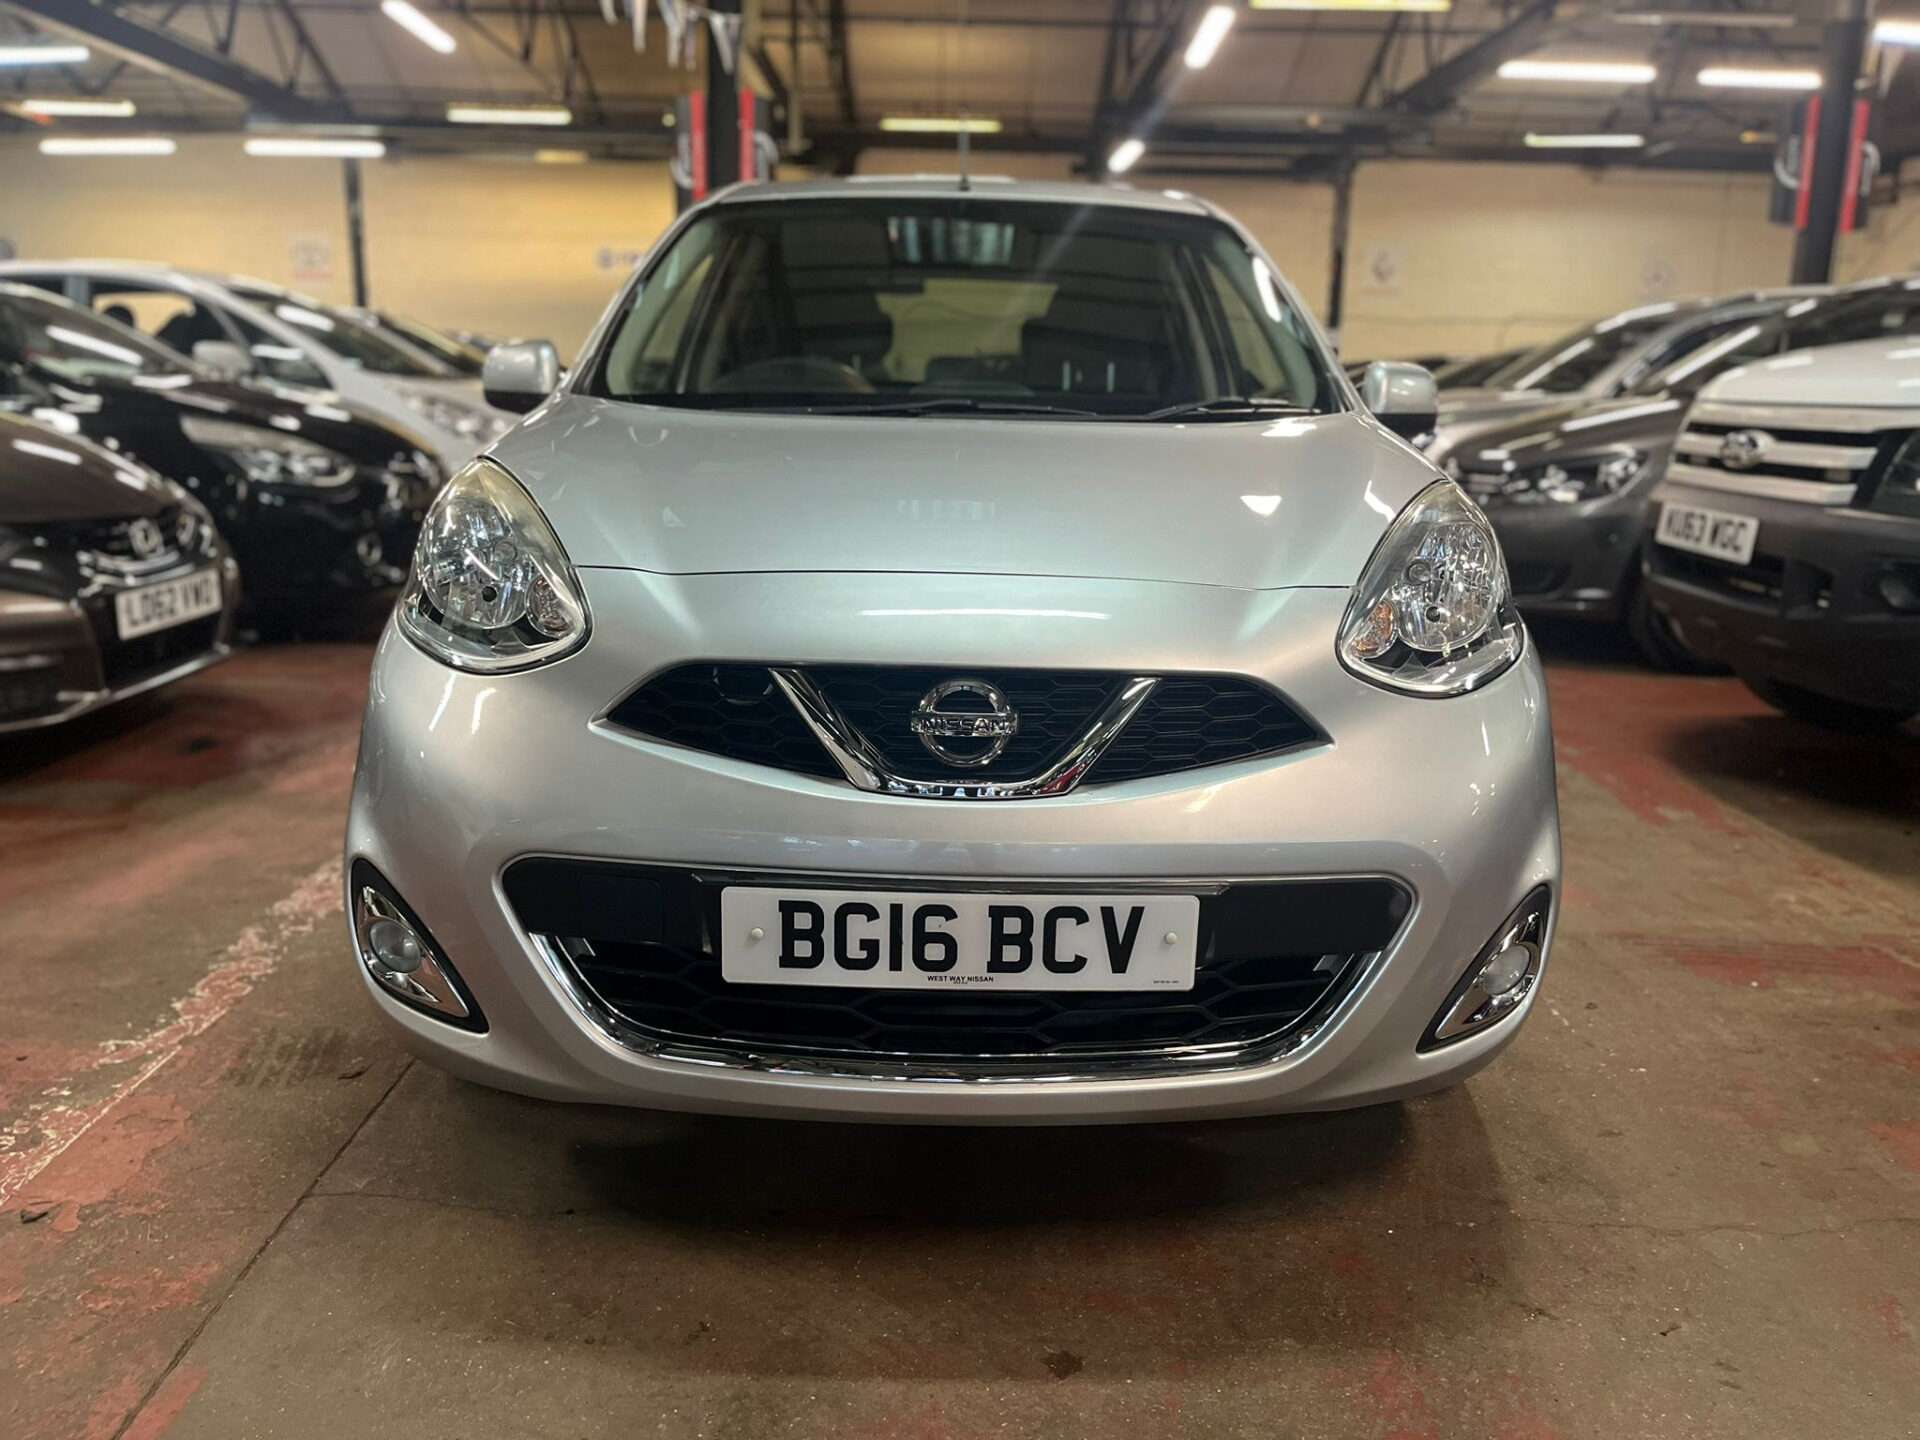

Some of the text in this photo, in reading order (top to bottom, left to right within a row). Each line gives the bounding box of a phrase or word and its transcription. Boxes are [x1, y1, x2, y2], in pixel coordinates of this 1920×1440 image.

[778, 899, 1146, 975] BG16 BCV
[967, 975, 994, 983] NISSAN
